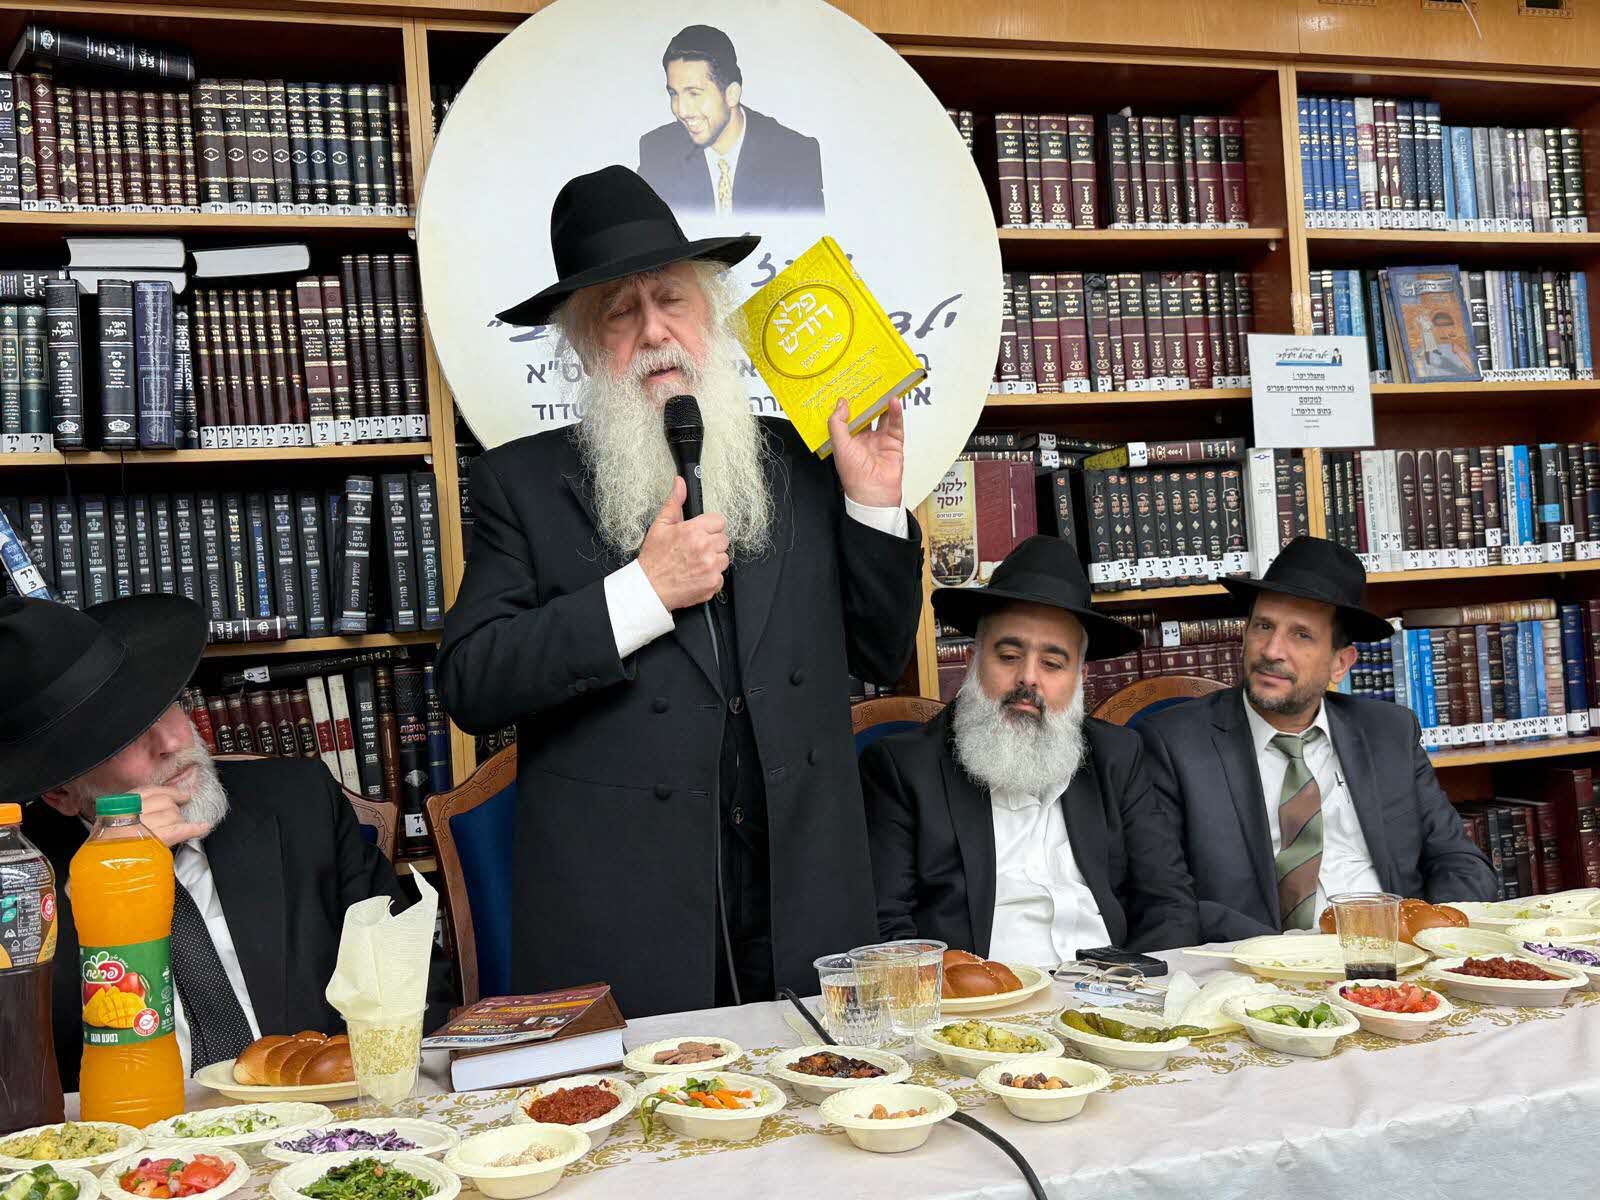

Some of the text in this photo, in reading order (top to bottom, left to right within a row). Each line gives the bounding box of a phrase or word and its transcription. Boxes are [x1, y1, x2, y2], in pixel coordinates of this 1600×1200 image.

[773, 292, 817, 336] פלא
[778, 304, 835, 356] דורש
[937, 496, 964, 510] יוסף
